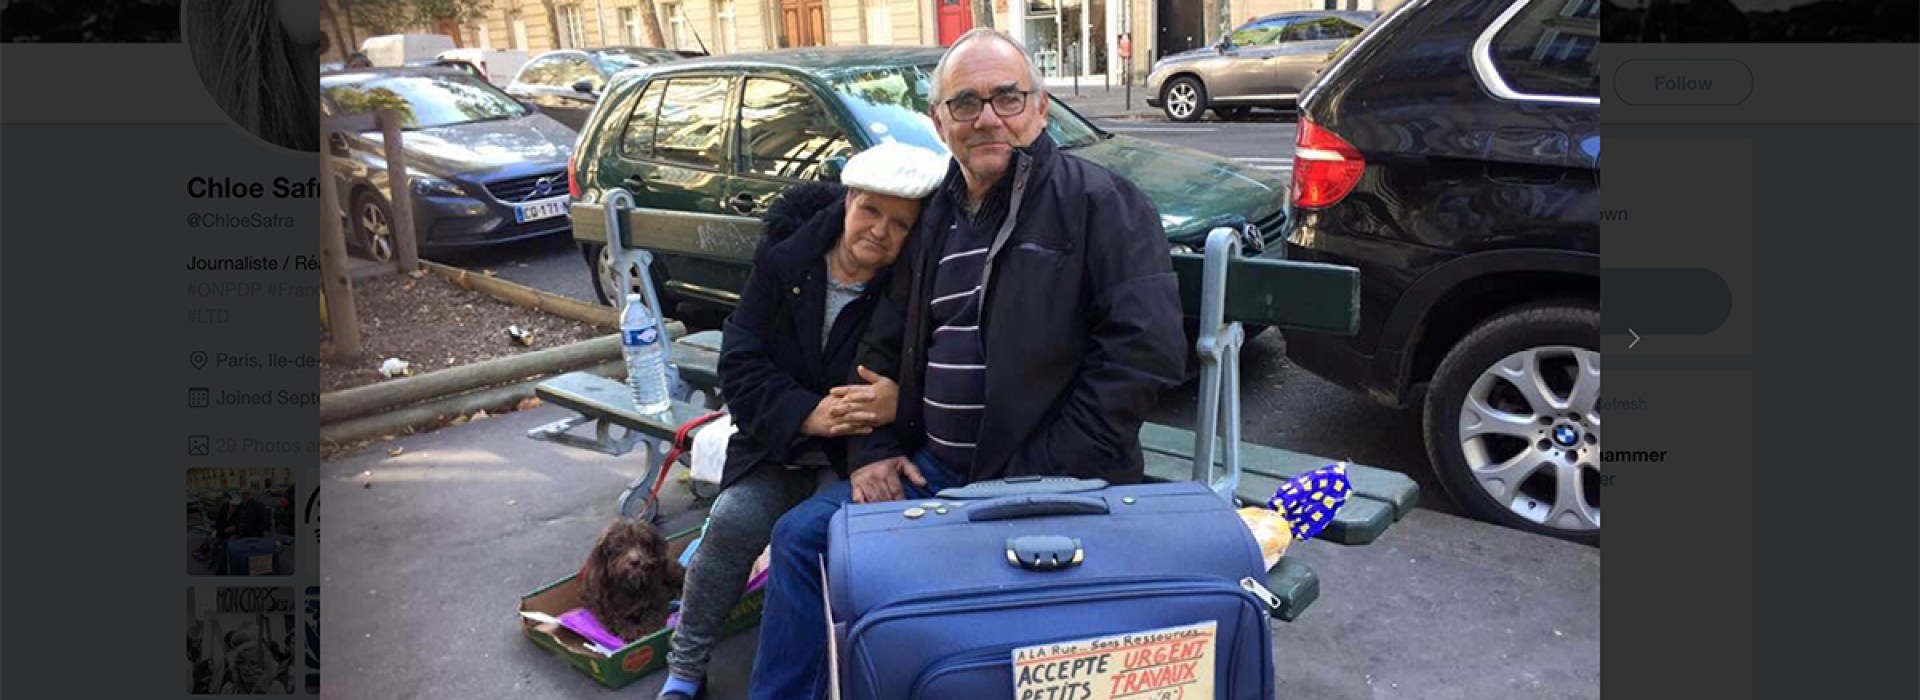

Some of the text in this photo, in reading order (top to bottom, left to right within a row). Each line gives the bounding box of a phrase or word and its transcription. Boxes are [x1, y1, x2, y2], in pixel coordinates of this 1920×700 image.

[1655, 75, 1713, 91] Follow
[187, 176, 265, 198] Chloe
[187, 212, 295, 228] @ChloeSafra
[186, 255, 278, 271] Journaliste
[282, 255, 290, 271] /
[187, 282, 262, 297] #ONPDP
[187, 308, 230, 324] #LTD
[216, 352, 262, 369] Paris,
[216, 390, 272, 405] Joined
[215, 438, 237, 453] 29
[242, 437, 301, 453] Photos
[1017, 653, 1111, 688] ACCEPTE
[1110, 660, 1198, 697] TRAVAUX
